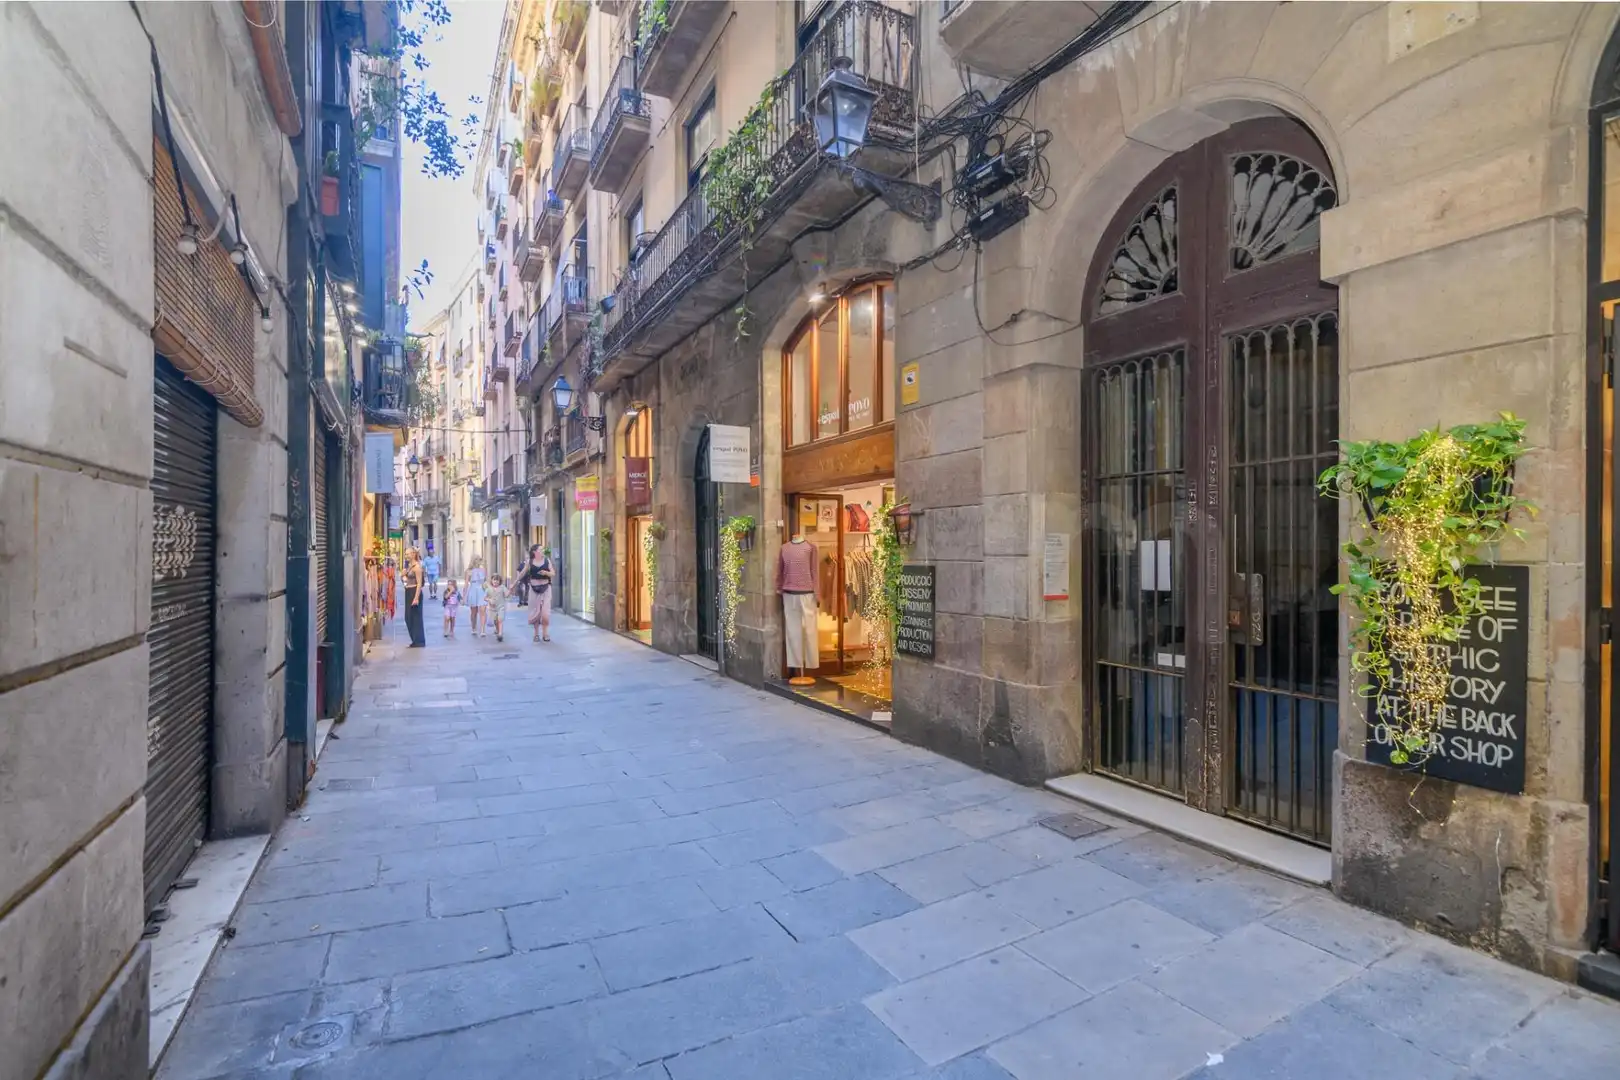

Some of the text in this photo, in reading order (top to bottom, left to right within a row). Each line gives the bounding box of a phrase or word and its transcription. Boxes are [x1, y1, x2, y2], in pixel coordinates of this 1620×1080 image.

[902, 587, 932, 600] DISSENY
[898, 614, 932, 628] SUSTAINABLE
[898, 626, 932, 641] PRODUCTION
[1477, 615, 1519, 643] OF
[898, 639, 932, 654] AND DESIGN
[1375, 694, 1404, 720] AT
[1461, 707, 1518, 740] BACK
[1374, 723, 1403, 747] OF
[1449, 735, 1514, 768] SHOP
